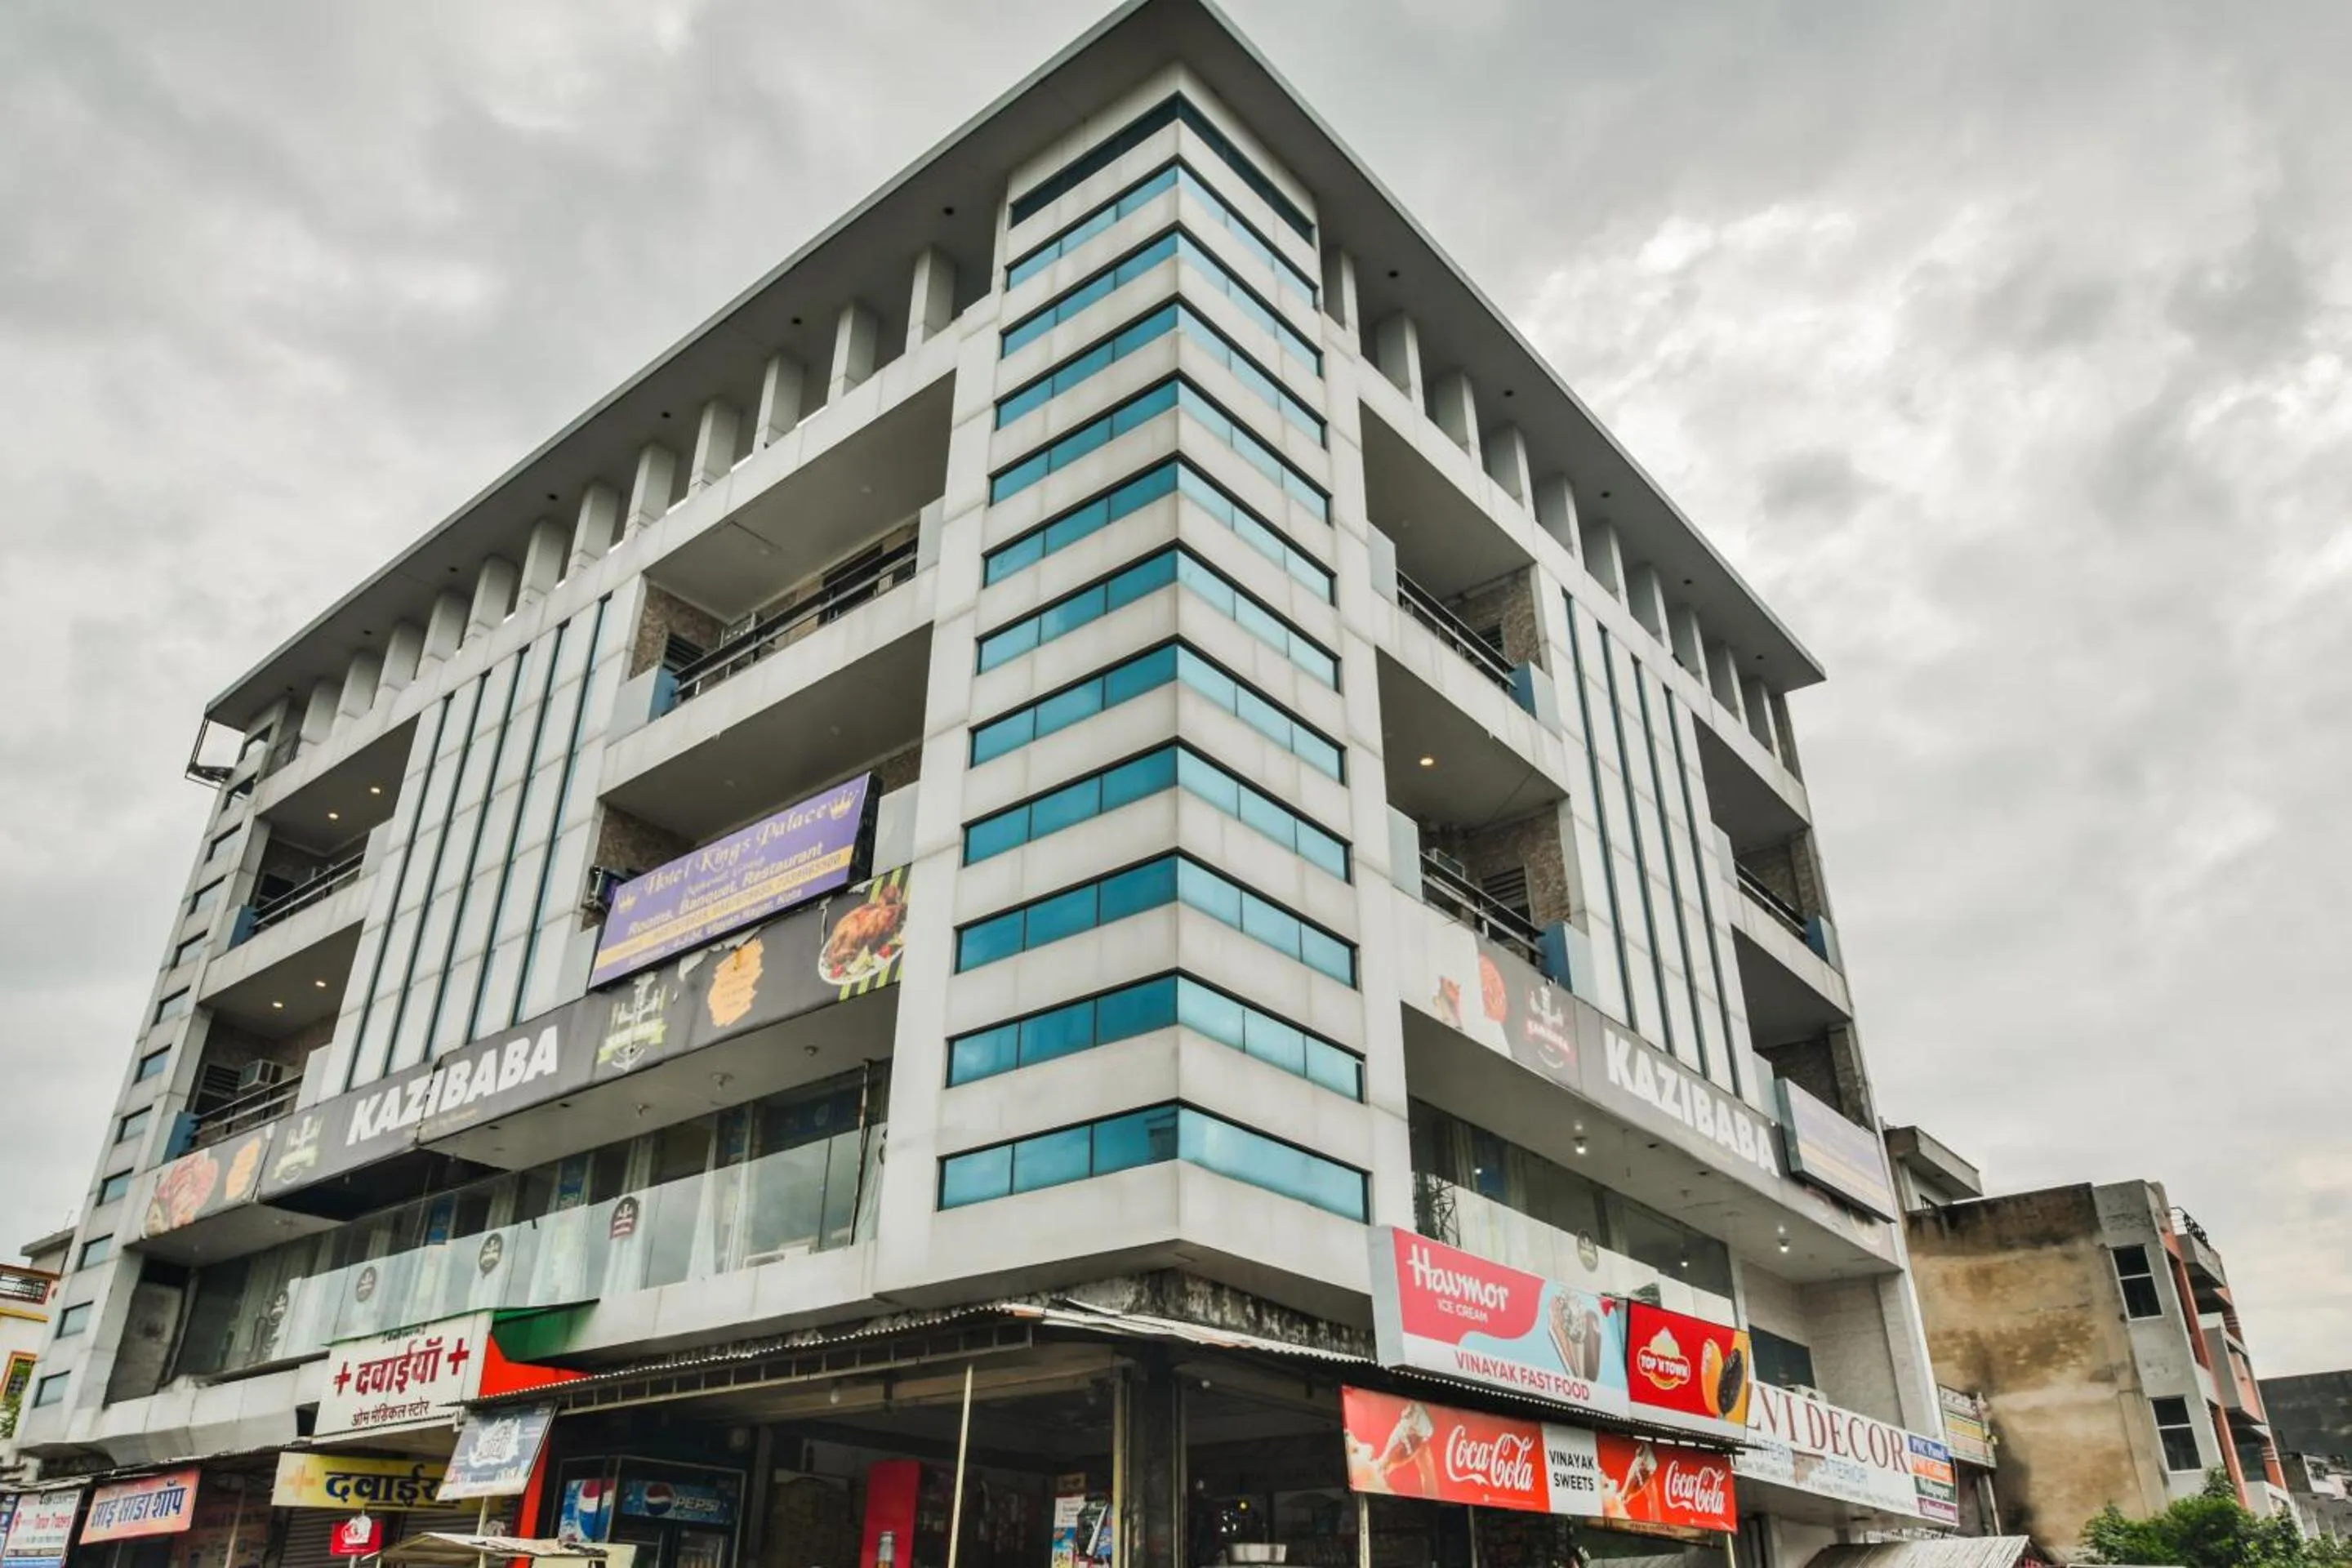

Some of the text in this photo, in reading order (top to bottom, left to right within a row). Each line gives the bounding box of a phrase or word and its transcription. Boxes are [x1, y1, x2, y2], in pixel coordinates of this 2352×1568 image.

[345, 1026, 559, 1147] KAZIBABA
[1603, 1027, 1780, 1178] KAZIBABA
[1407, 1242, 1509, 1312] Havmor
[1437, 1299, 1489, 1324] ICE CREAM
[1454, 1350, 1590, 1402] VINAYAK FAST FOOD
[1445, 1424, 1534, 1492] Coca-Cola
[1548, 1450, 1595, 1471] VINAYAK
[1805, 1401, 1909, 1474] DECOR
[1554, 1472, 1594, 1493] SWEETS
[1664, 1460, 1726, 1516] Coca-Cola
